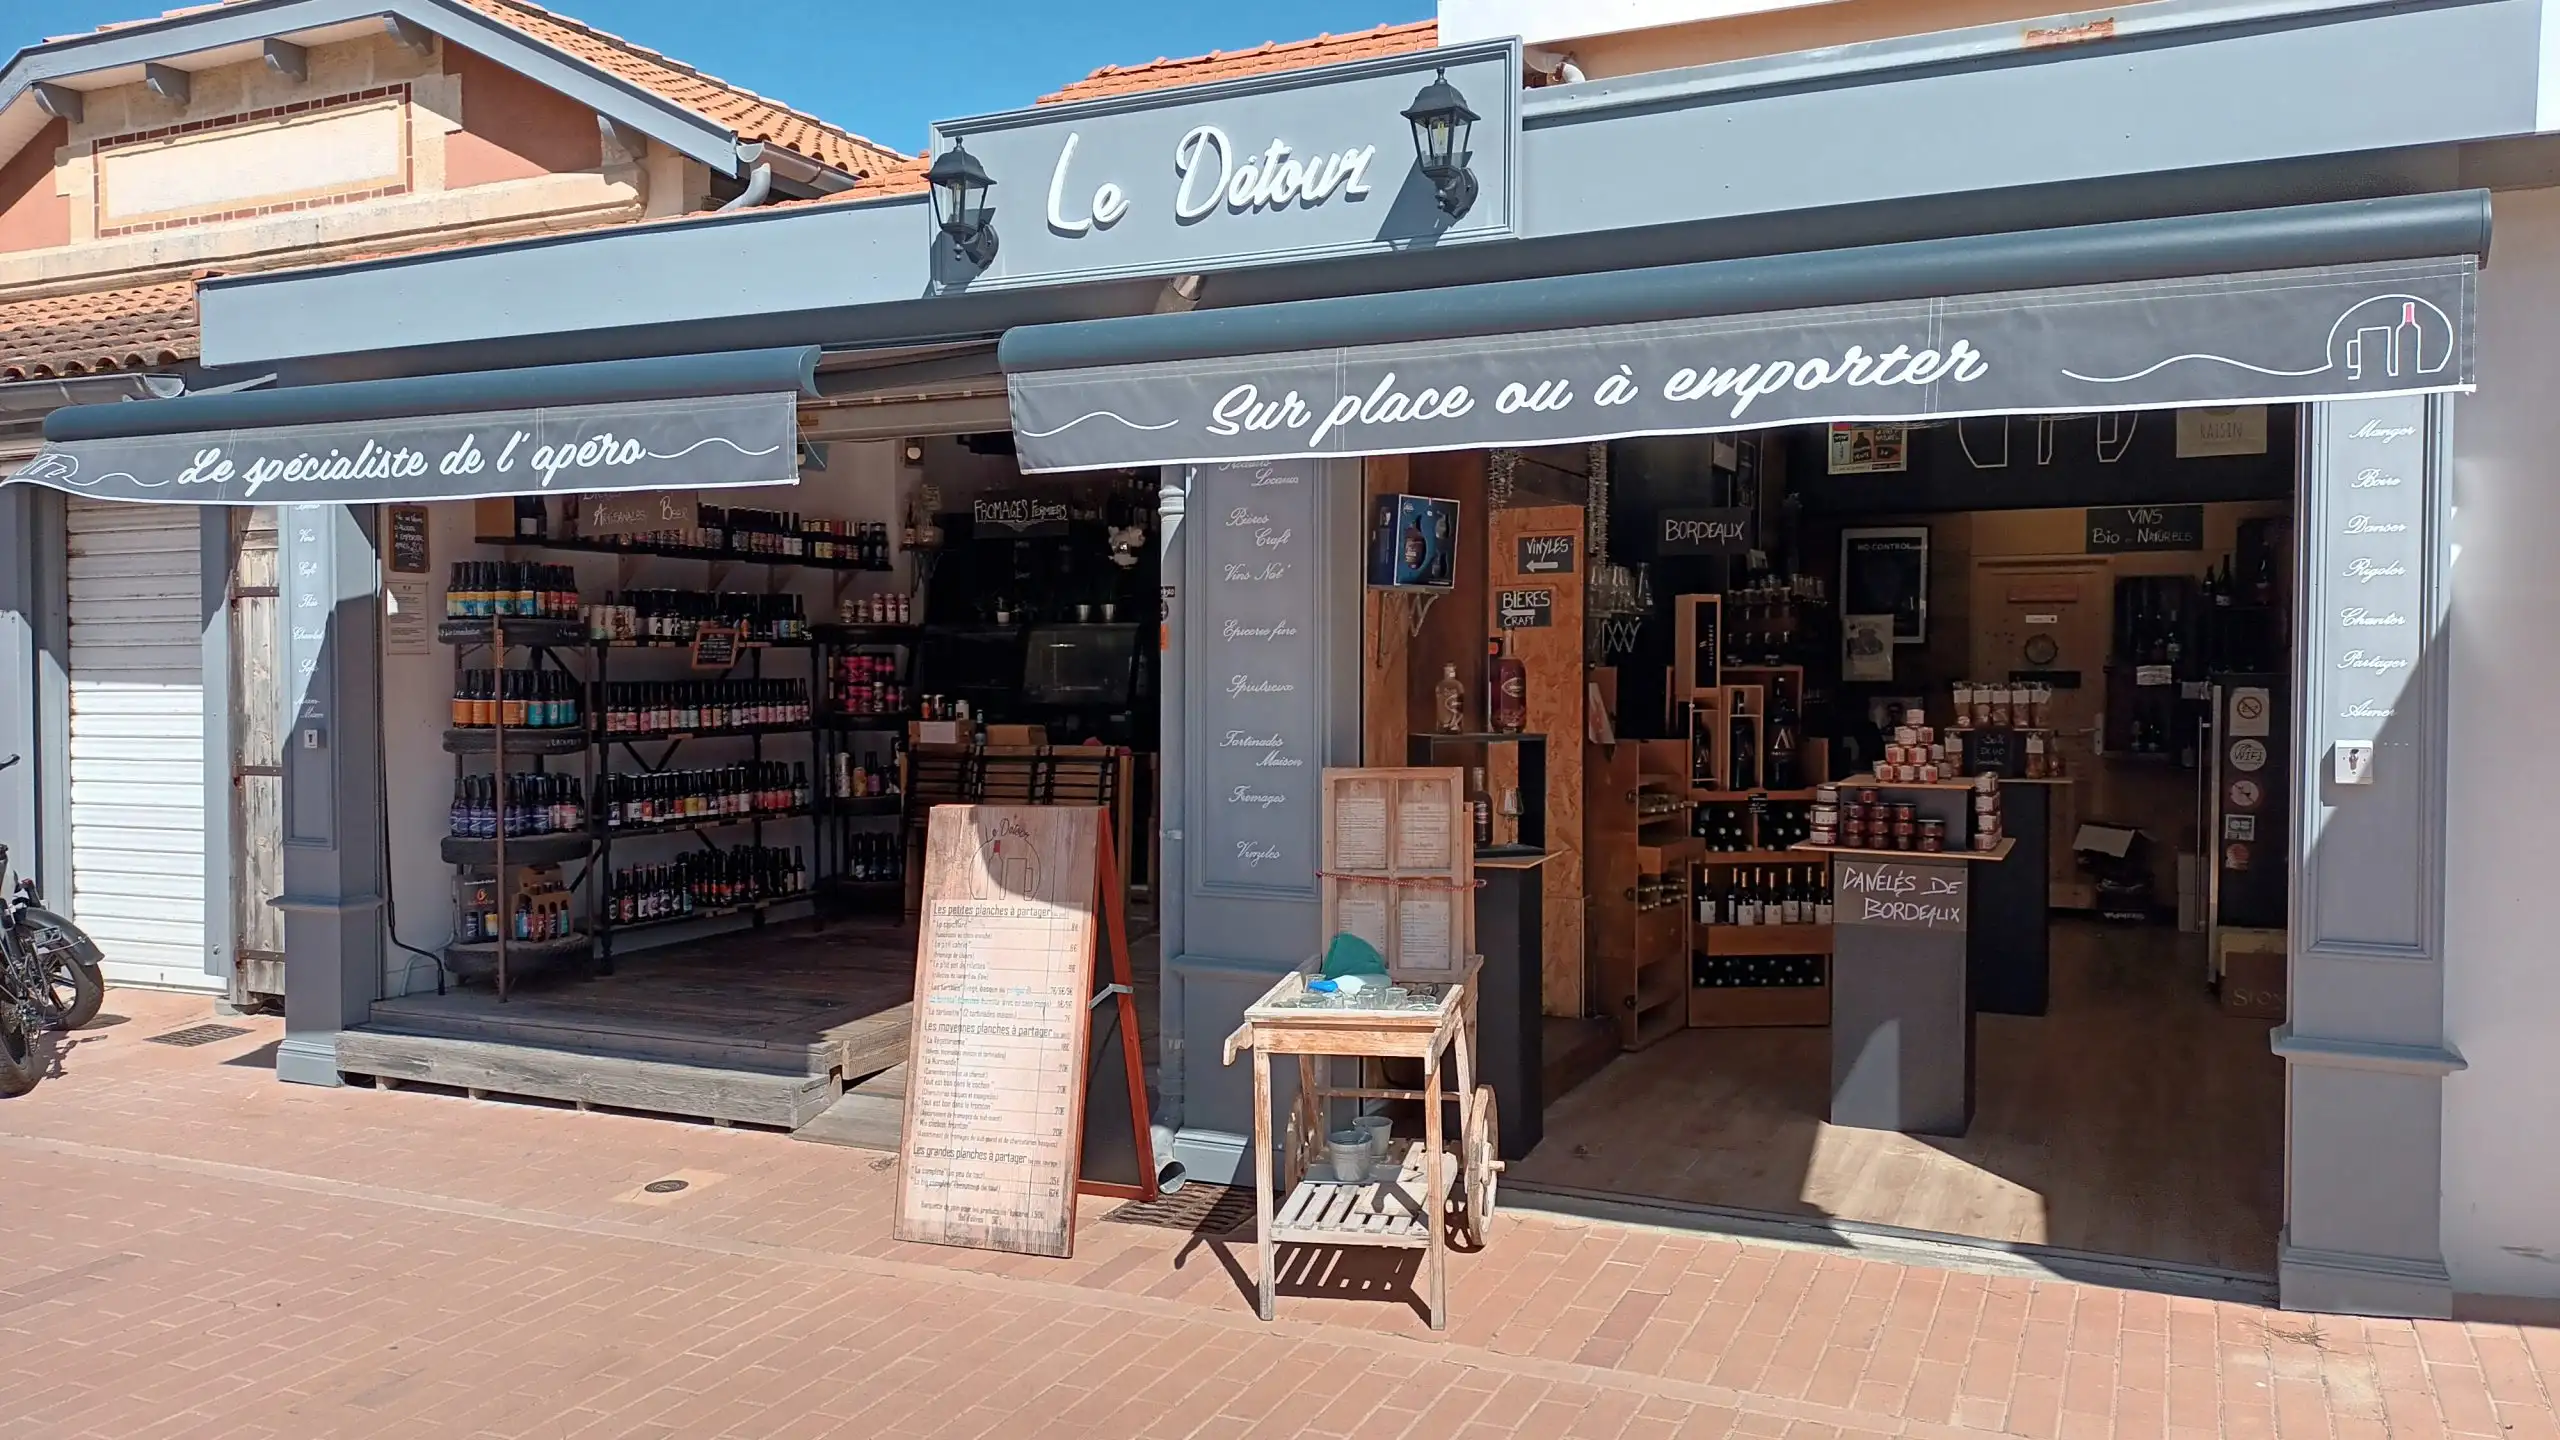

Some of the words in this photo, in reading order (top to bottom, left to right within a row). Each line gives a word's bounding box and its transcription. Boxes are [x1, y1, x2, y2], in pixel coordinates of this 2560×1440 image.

[1047, 132, 1131, 236] Le
[1175, 125, 1376, 222] Détour
[1206, 384, 1312, 437] Sur
[1308, 372, 1476, 448] place
[1495, 379, 1574, 414] ou
[1594, 364, 1639, 406] à
[1663, 339, 1989, 419] emporter
[2349, 418, 2416, 444] Manger
[178, 447, 236, 485] Le
[243, 438, 428, 498] spécialiste
[439, 432, 485, 476] de
[2351, 468, 2401, 488] Boire
[974, 499, 1028, 523] FROMAGES
[2127, 508, 2163, 525] VINS
[1665, 519, 1745, 545] BORDEAUX
[2343, 514, 2408, 535] Danser
[1254, 527, 1292, 550] Craft
[2093, 528, 2120, 544] Bio
[1526, 538, 1569, 562] VINYLES
[1224, 563, 1251, 582] Vins
[2342, 557, 2407, 584] Rigoler
[1504, 616, 1535, 627] CRAFT
[2340, 607, 2406, 627] Chanter
[2337, 649, 2408, 676] Partager
[2340, 698, 2397, 718] Aimer
[1219, 730, 1284, 748] Tartinades
[1255, 750, 1303, 768] Maison
[1228, 785, 1286, 809] Fromages
[1920, 877, 1964, 895] DE
[934, 903, 946, 914] Les
[948, 905, 973, 916] petites
[975, 905, 1008, 917] planches
[1010, 906, 1015, 915] à
[1862, 898, 1960, 927] BORDEAUX
[924, 1020, 936, 1032] Les
[977, 1020, 1010, 1035] planches
[1012, 1024, 1017, 1034] à
[913, 1143, 925, 1155] Les
[926, 1145, 954, 1157] grandes
[956, 1147, 987, 1161] planches
[995, 1152, 1027, 1165] partager
